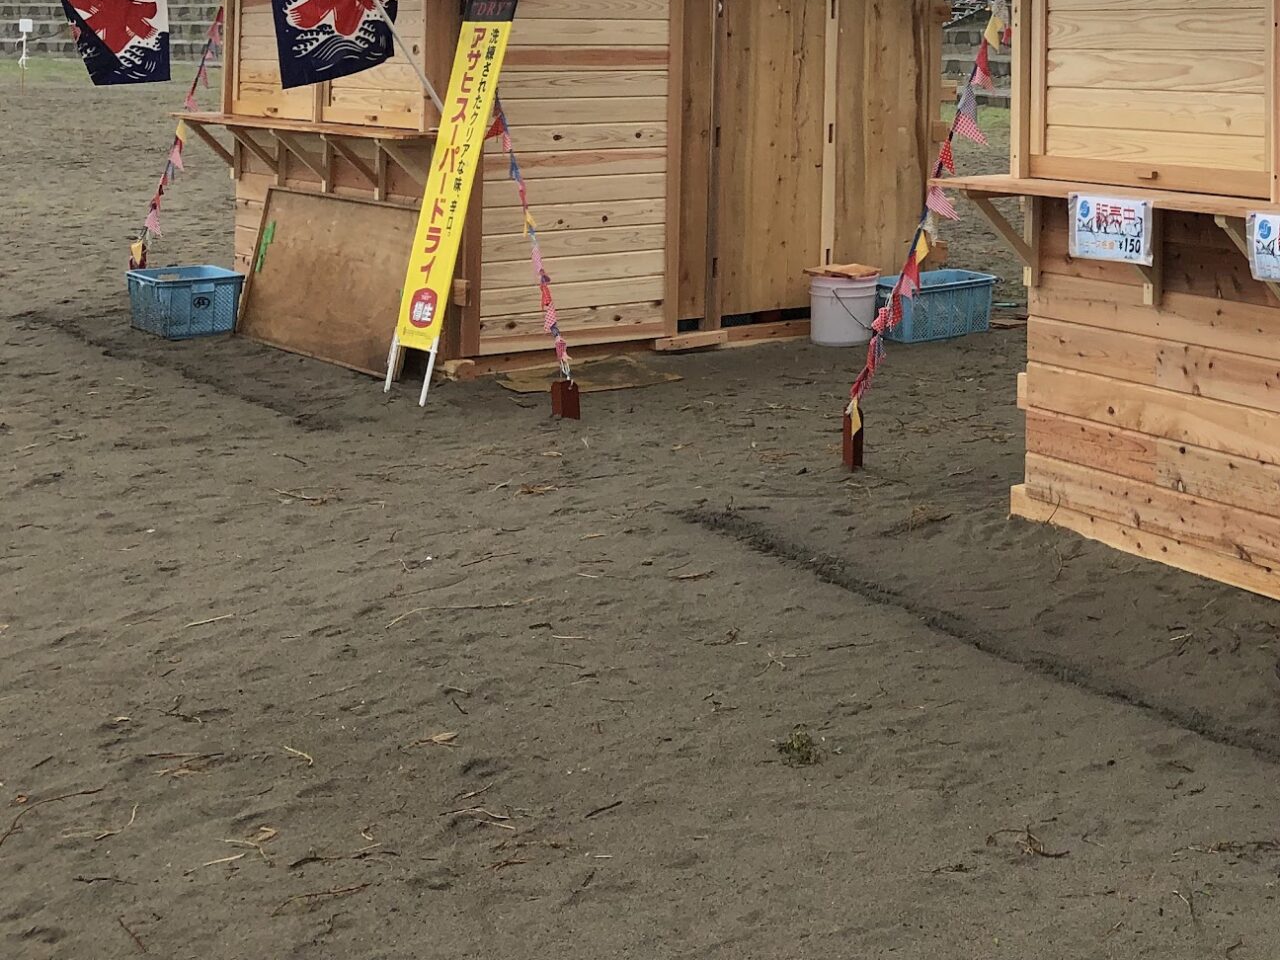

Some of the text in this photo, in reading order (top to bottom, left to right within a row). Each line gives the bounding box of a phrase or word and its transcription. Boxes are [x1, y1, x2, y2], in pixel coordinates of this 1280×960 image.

[420, 27, 487, 284] アサヒスーパードライ
